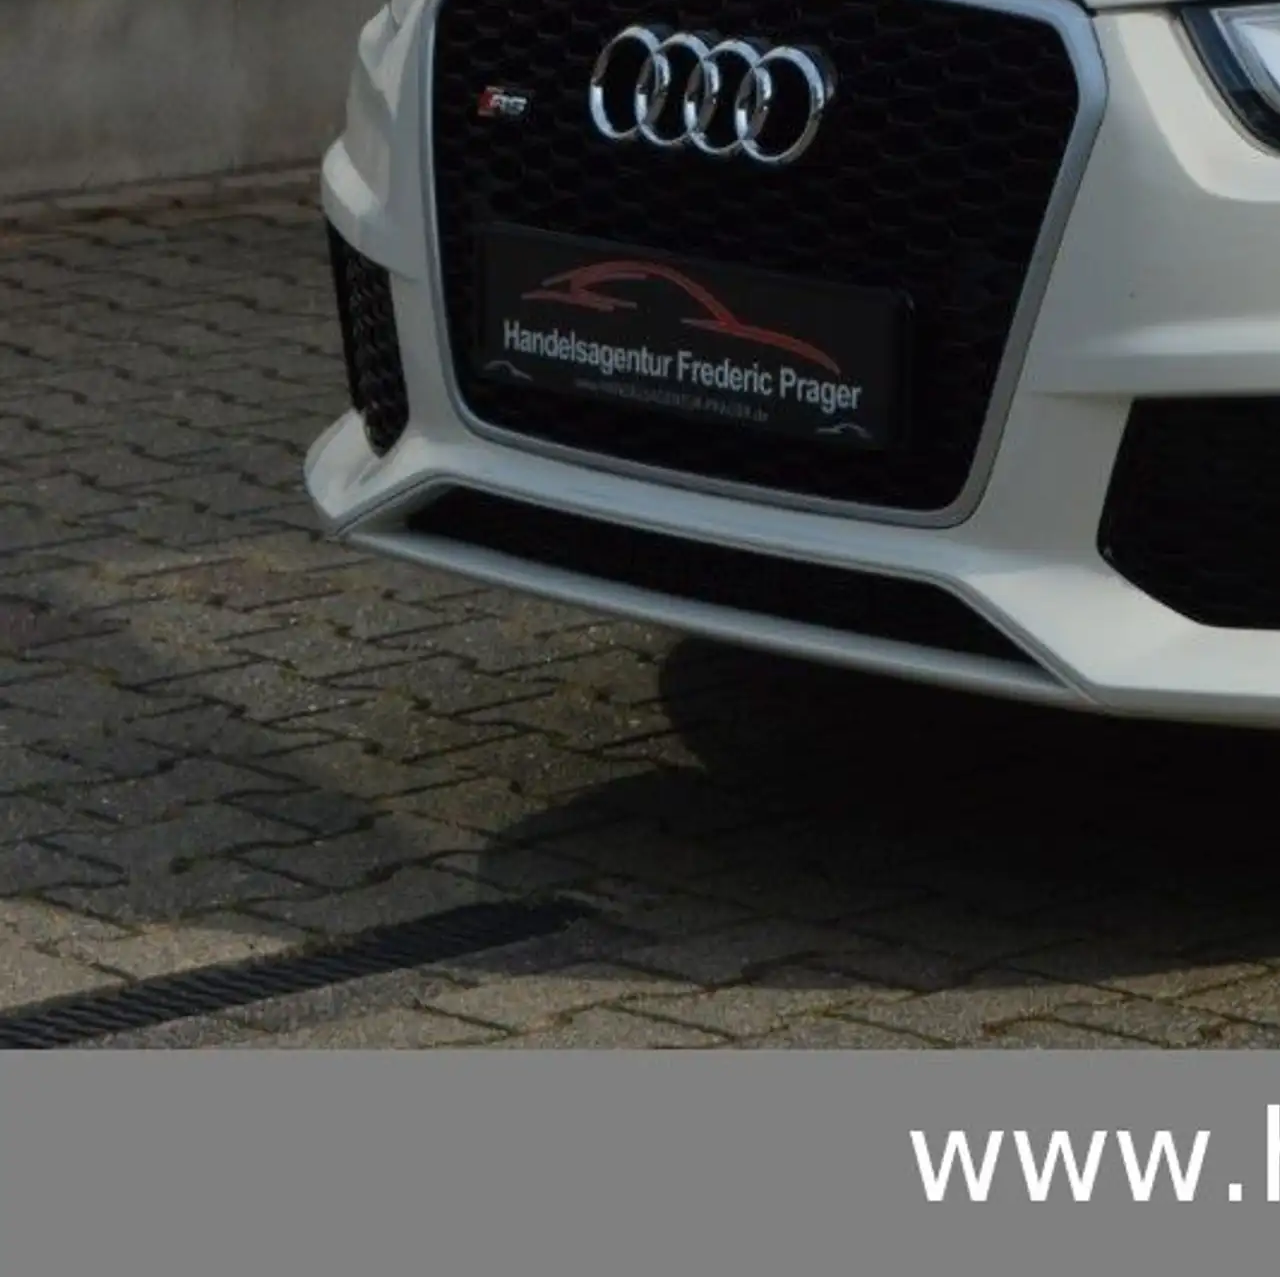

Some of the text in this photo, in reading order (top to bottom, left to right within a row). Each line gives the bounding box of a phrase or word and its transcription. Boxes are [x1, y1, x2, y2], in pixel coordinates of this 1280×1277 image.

[502, 317, 673, 378] Handelsagentur
[675, 349, 773, 397] Frederic
[778, 365, 863, 415] Prager
